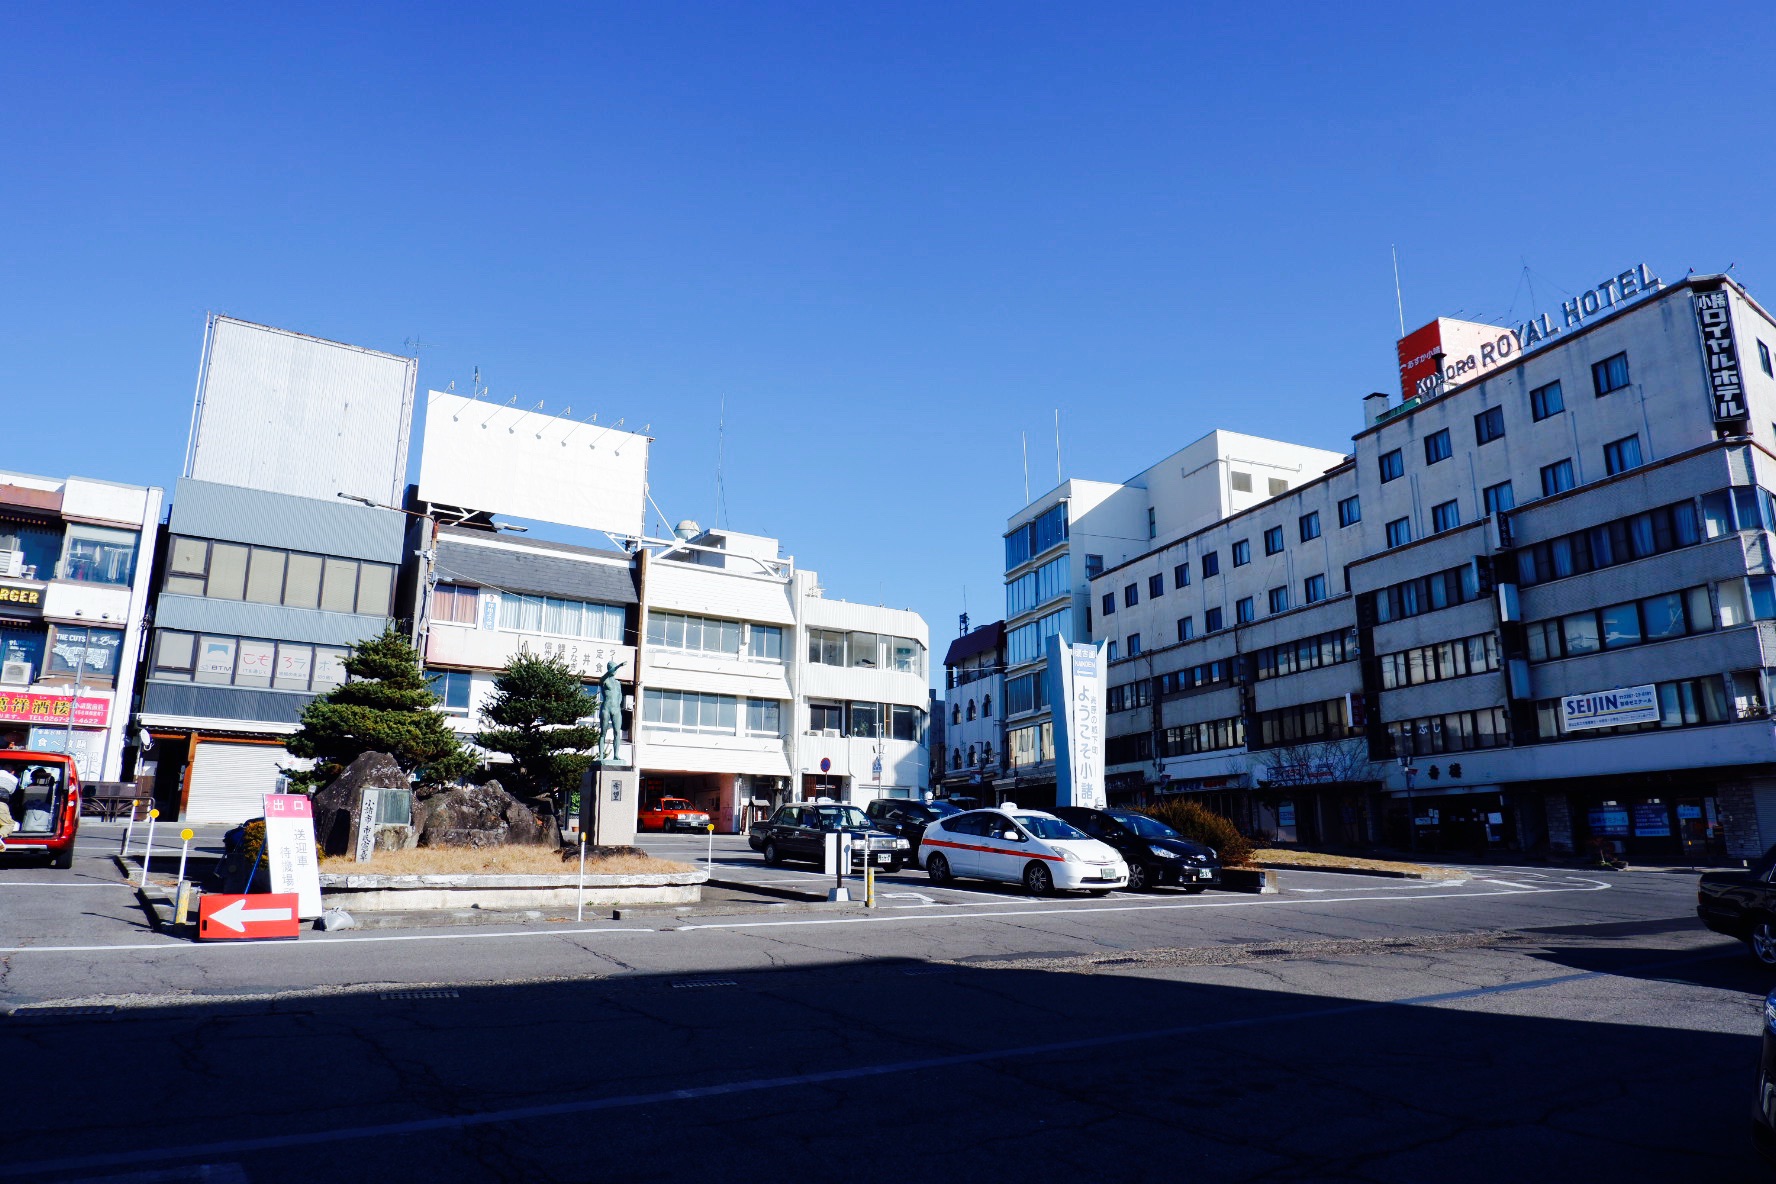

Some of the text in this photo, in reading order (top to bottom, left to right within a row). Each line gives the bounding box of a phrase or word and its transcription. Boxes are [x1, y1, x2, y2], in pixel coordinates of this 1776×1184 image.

[1481, 313, 1561, 367] ROYAL
[1562, 263, 1662, 327] HOTEL
[1697, 293, 1745, 417] 小諸ロイヤルホテル
[56, 633, 68, 641] THE
[69, 634, 86, 642] CUTS
[570, 645, 578, 672] うなぎ
[595, 648, 603, 674] 定食
[1566, 694, 1619, 717] SEIJIN
[273, 798, 304, 811] 出口
[294, 828, 309, 868] 送迎車
